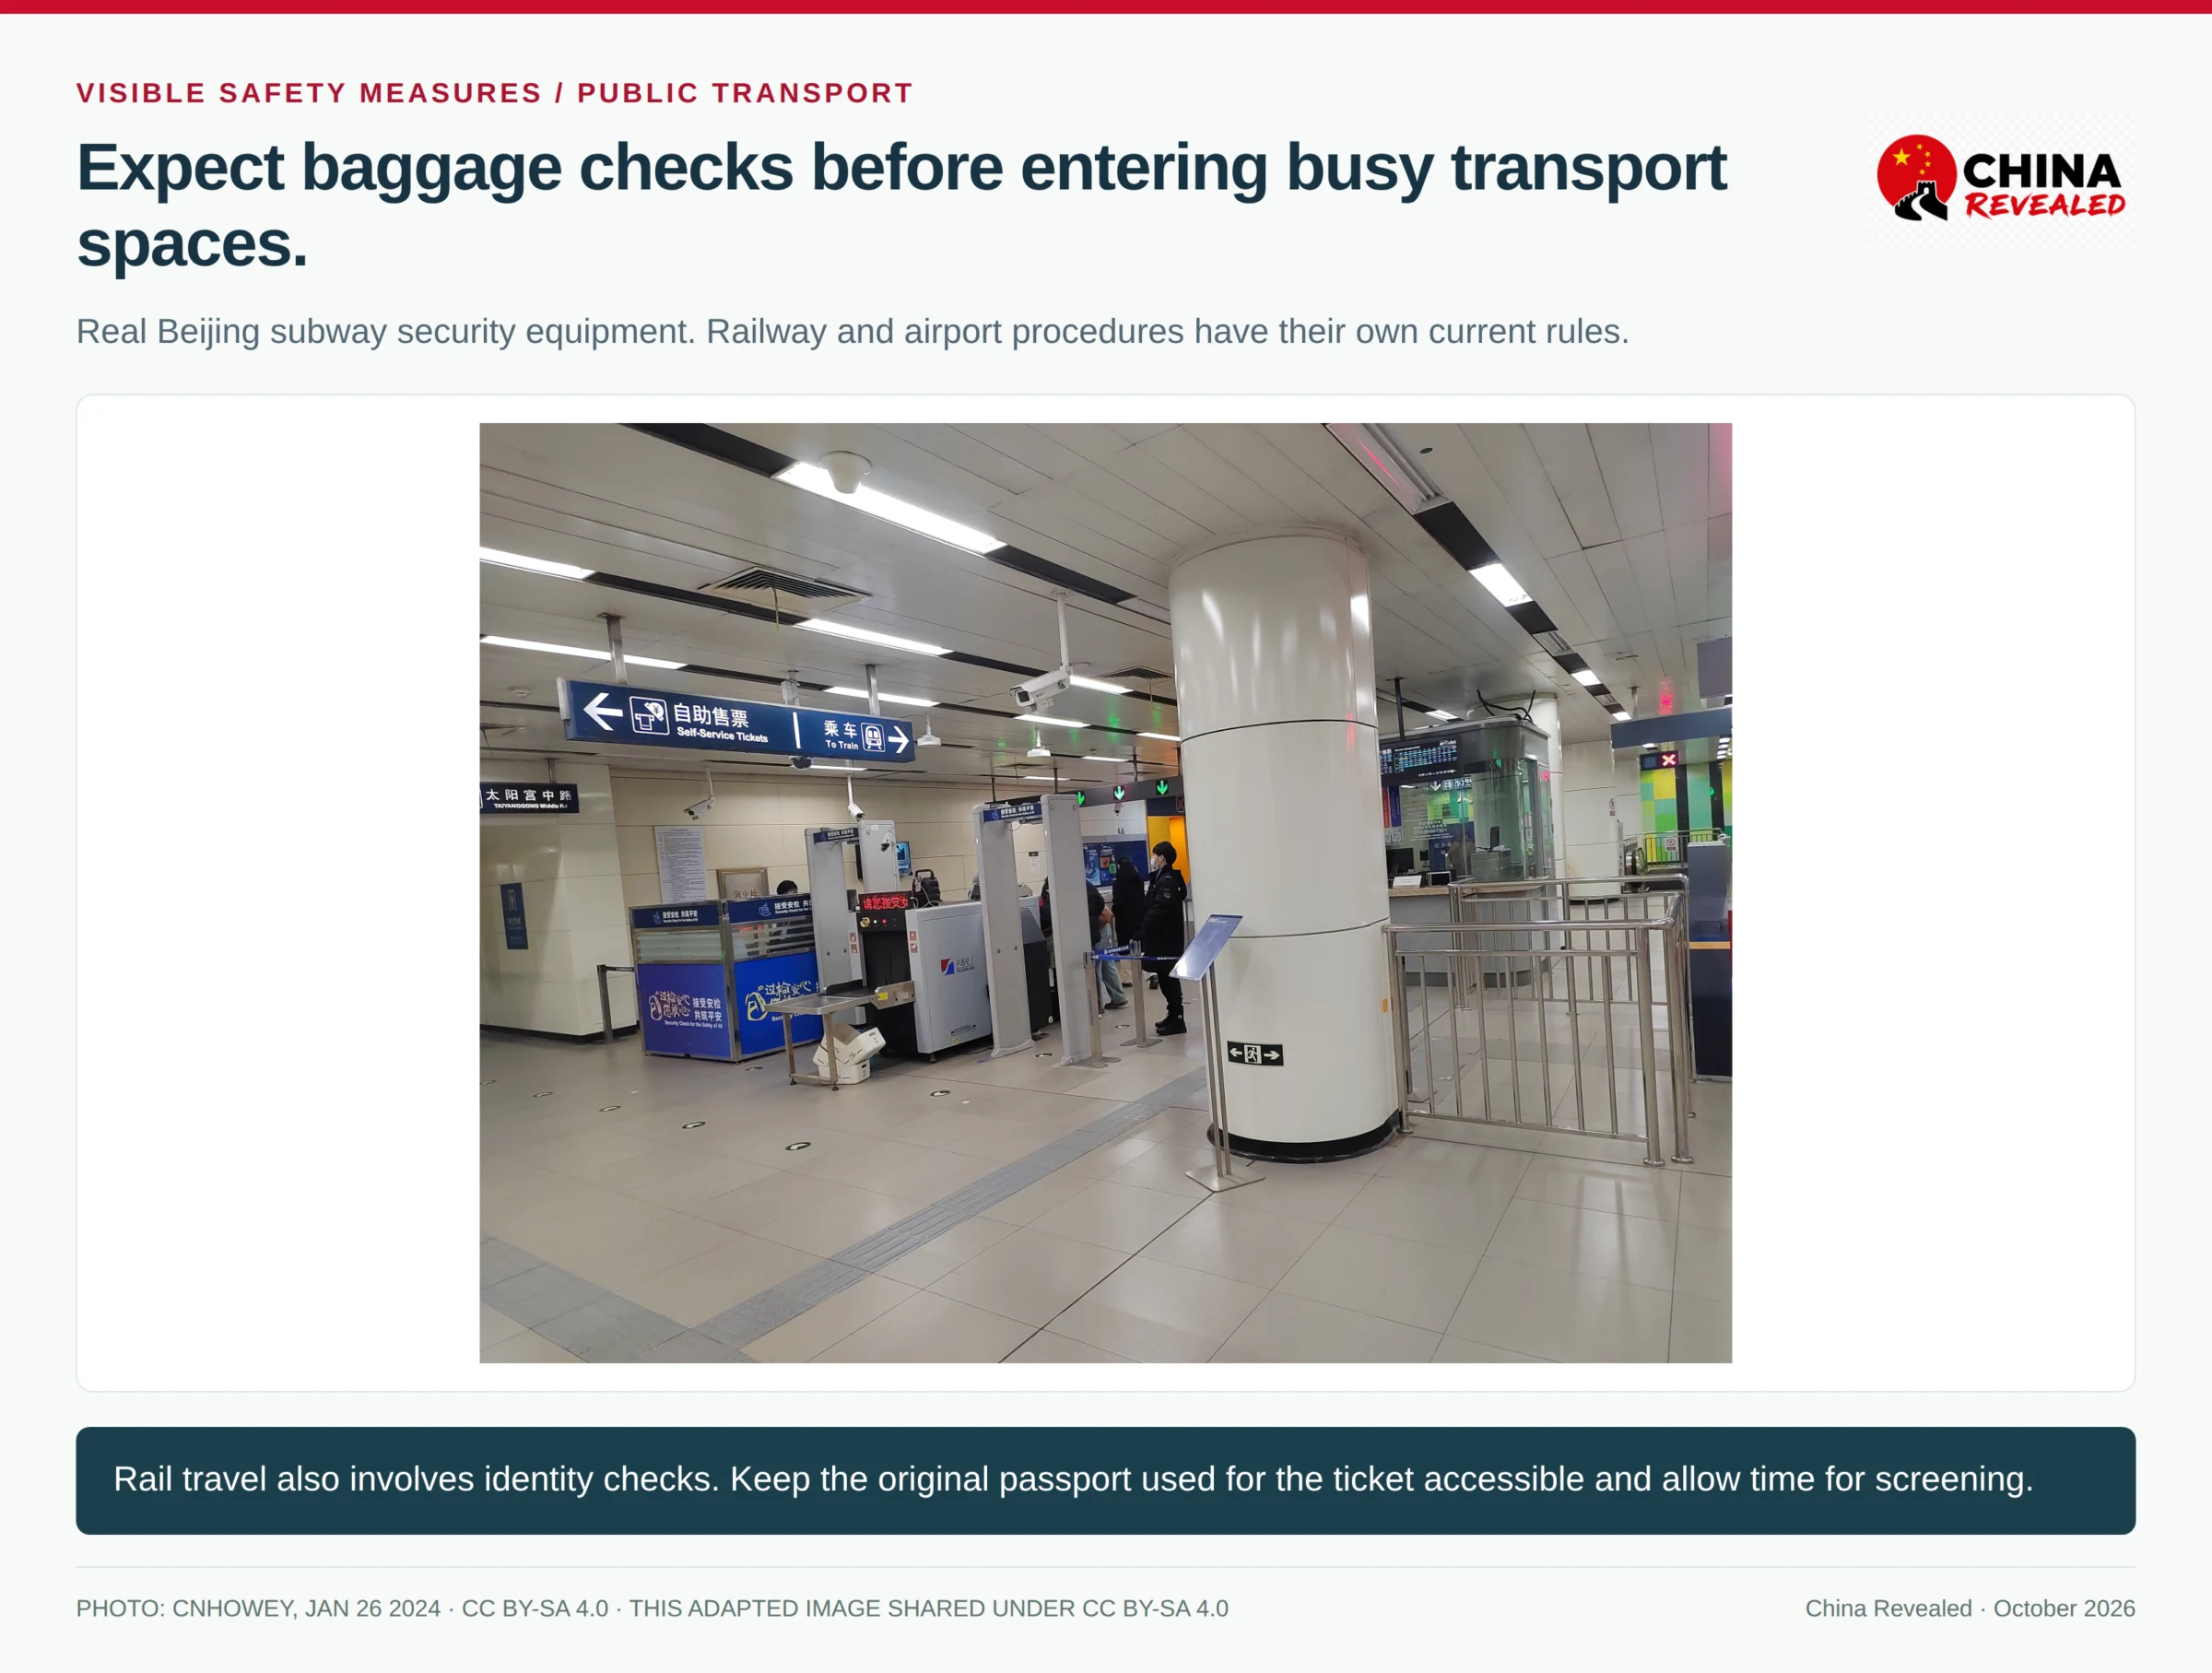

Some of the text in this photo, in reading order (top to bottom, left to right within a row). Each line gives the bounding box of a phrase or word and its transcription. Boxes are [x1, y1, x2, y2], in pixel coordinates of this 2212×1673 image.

[674, 702, 749, 729] 自助售票
[677, 726, 769, 744] Self-Service Tickets
[824, 720, 858, 738] 乘车
[826, 740, 859, 751] To Train
[486, 788, 572, 802] 太阳宫中路
[692, 997, 722, 1009] 接受安检
[694, 1010, 723, 1022] 共筑平安
